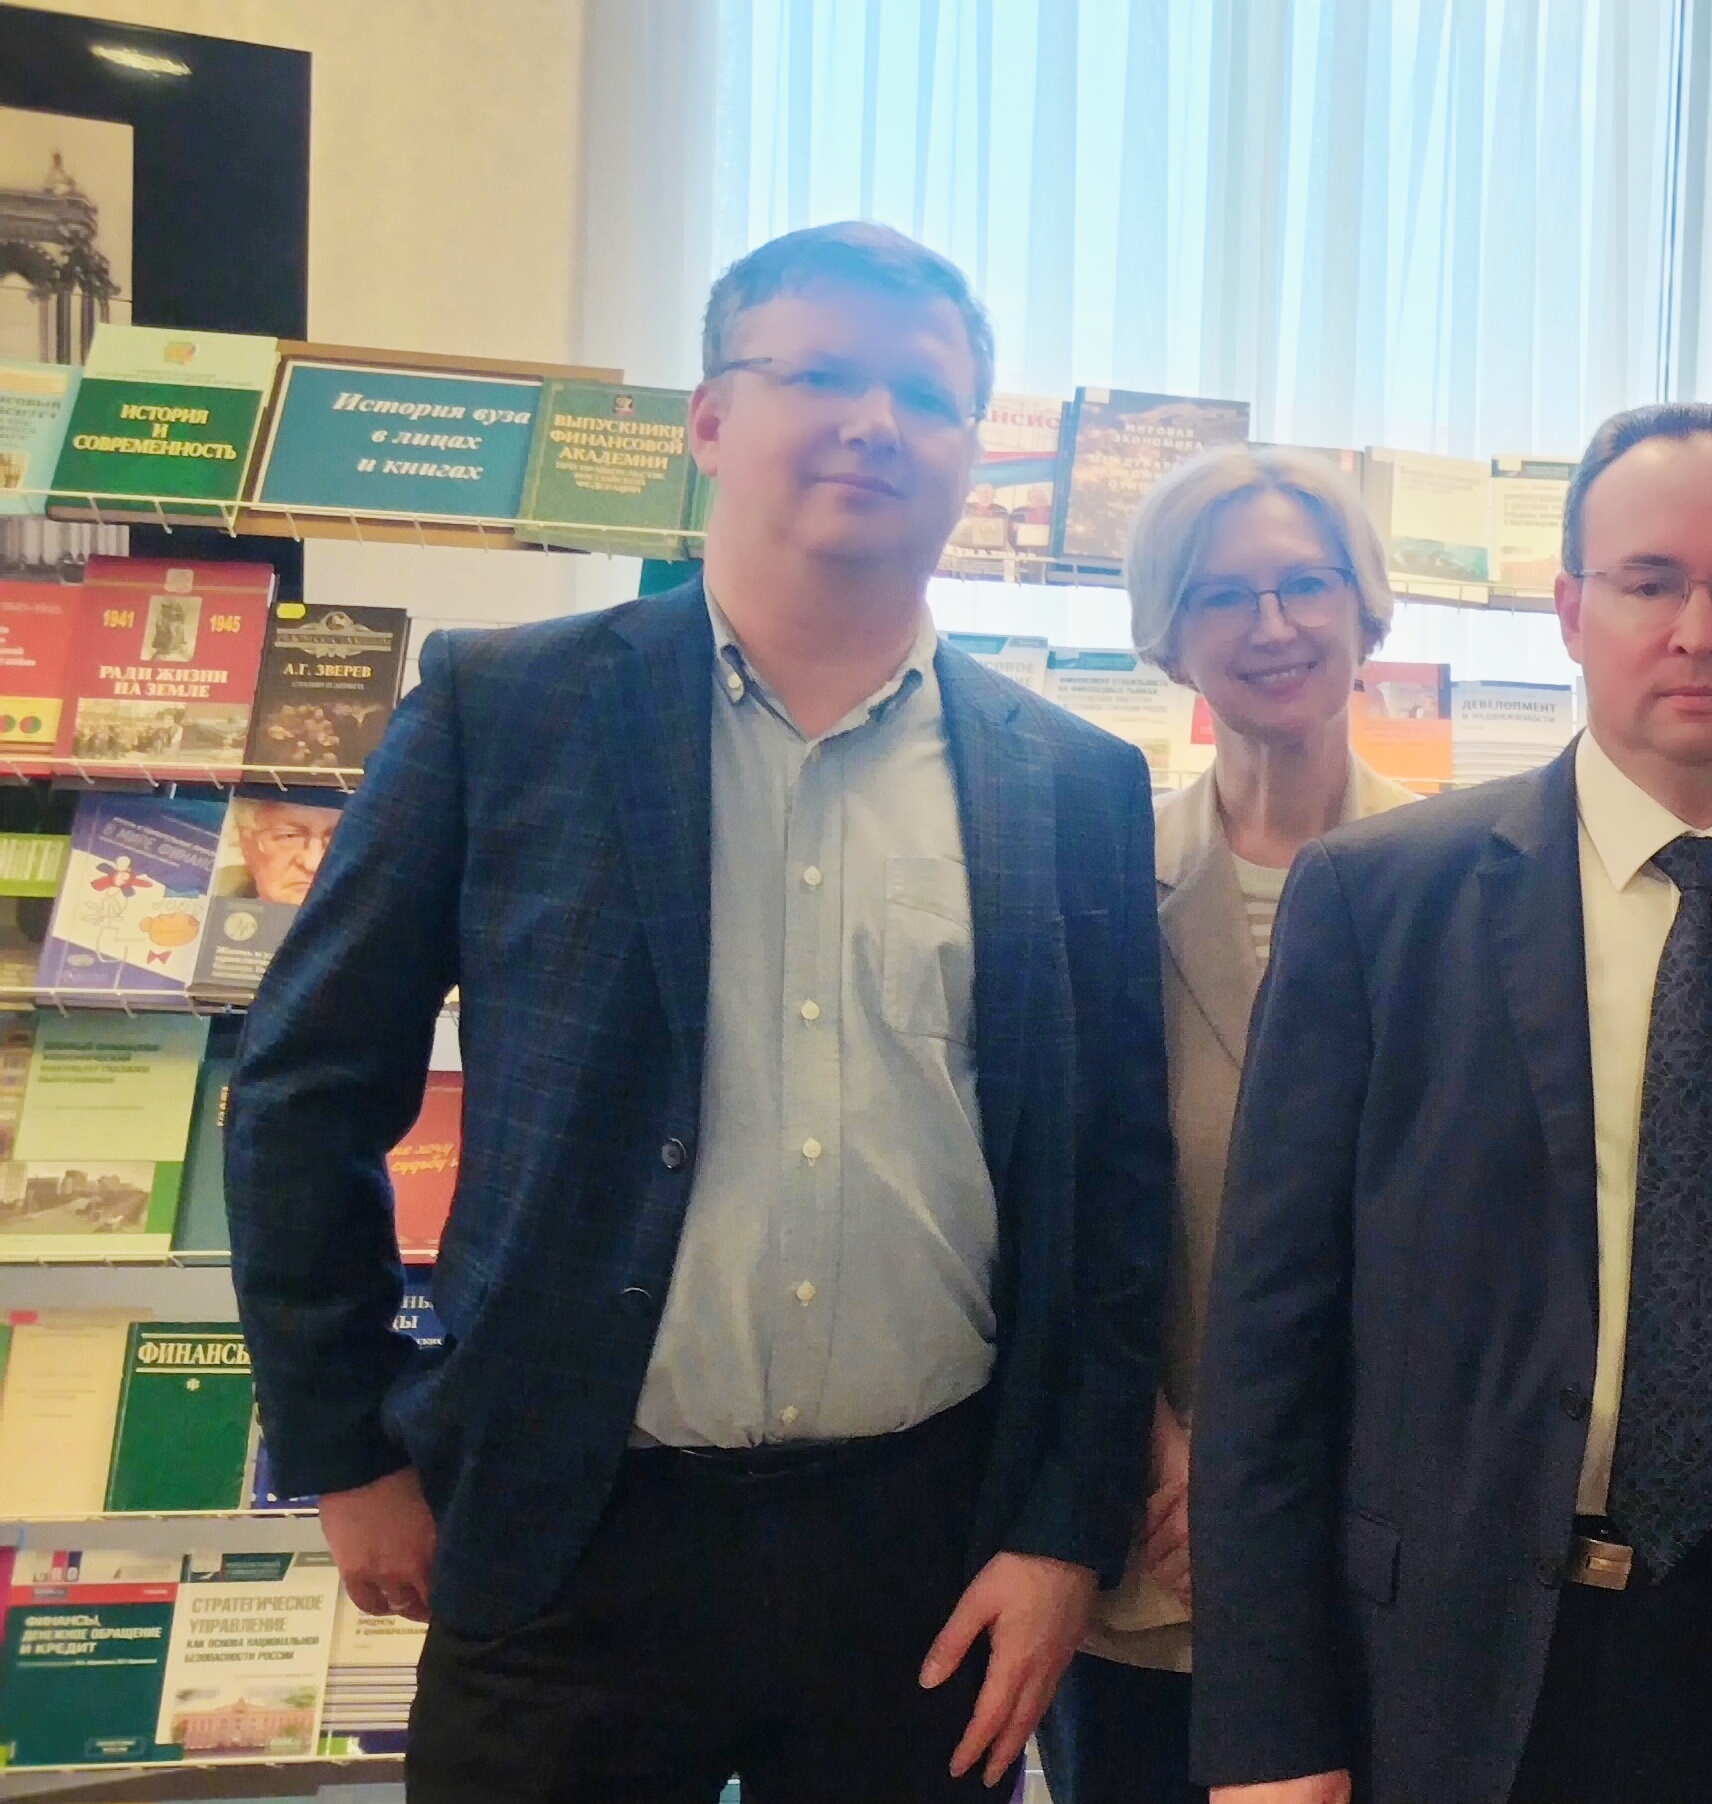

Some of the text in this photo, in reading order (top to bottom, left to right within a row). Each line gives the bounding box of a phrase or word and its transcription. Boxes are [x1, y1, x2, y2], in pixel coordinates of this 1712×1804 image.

[120, 403, 209, 425] ИСТОРИЯ
[332, 391, 532, 426] История вуза
[152, 423, 169, 438] И
[554, 413, 685, 439] ВЫПУСКНИКИ
[1124, 423, 1194, 438] МИРОВАЯ
[72, 434, 238, 461] СОВРЕМЕННОСТЬ
[371, 429, 483, 451] в лицах
[550, 429, 684, 455] ФИНАНСОВОЙ
[559, 445, 669, 470] АКАДЕМИИ
[357, 458, 485, 481] и книгах
[103, 609, 242, 633] 1941 1945
[99, 665, 229, 684] РАДИ ЖИЗНИ
[283, 662, 372, 678] А.Г. ЗВЕРЕВ
[114, 681, 211, 698] НА ЗЕМЛЕ
[1461, 699, 1557, 713] ДЕВЕЛОПМЕНТ
[1472, 712, 1556, 723] НЕДВИЖИМОСТИ
[191, 1594, 325, 1614] СТРАТЕГИЧЕСКОЕ
[21, 1626, 163, 1643] ДЕНЕЖНОЕ ОБРАЩЕНИЕ
[188, 1616, 289, 1635] УПРАВЛЕНИЕ
[19, 1641, 98, 1656] И КРЕДИТ
[186, 1634, 320, 1649] КАК ОСНОВА НАЦИОНАЛЬНОЙ
[183, 1650, 295, 1663] БЕЗОПАСНОСТИ РОССИИ
